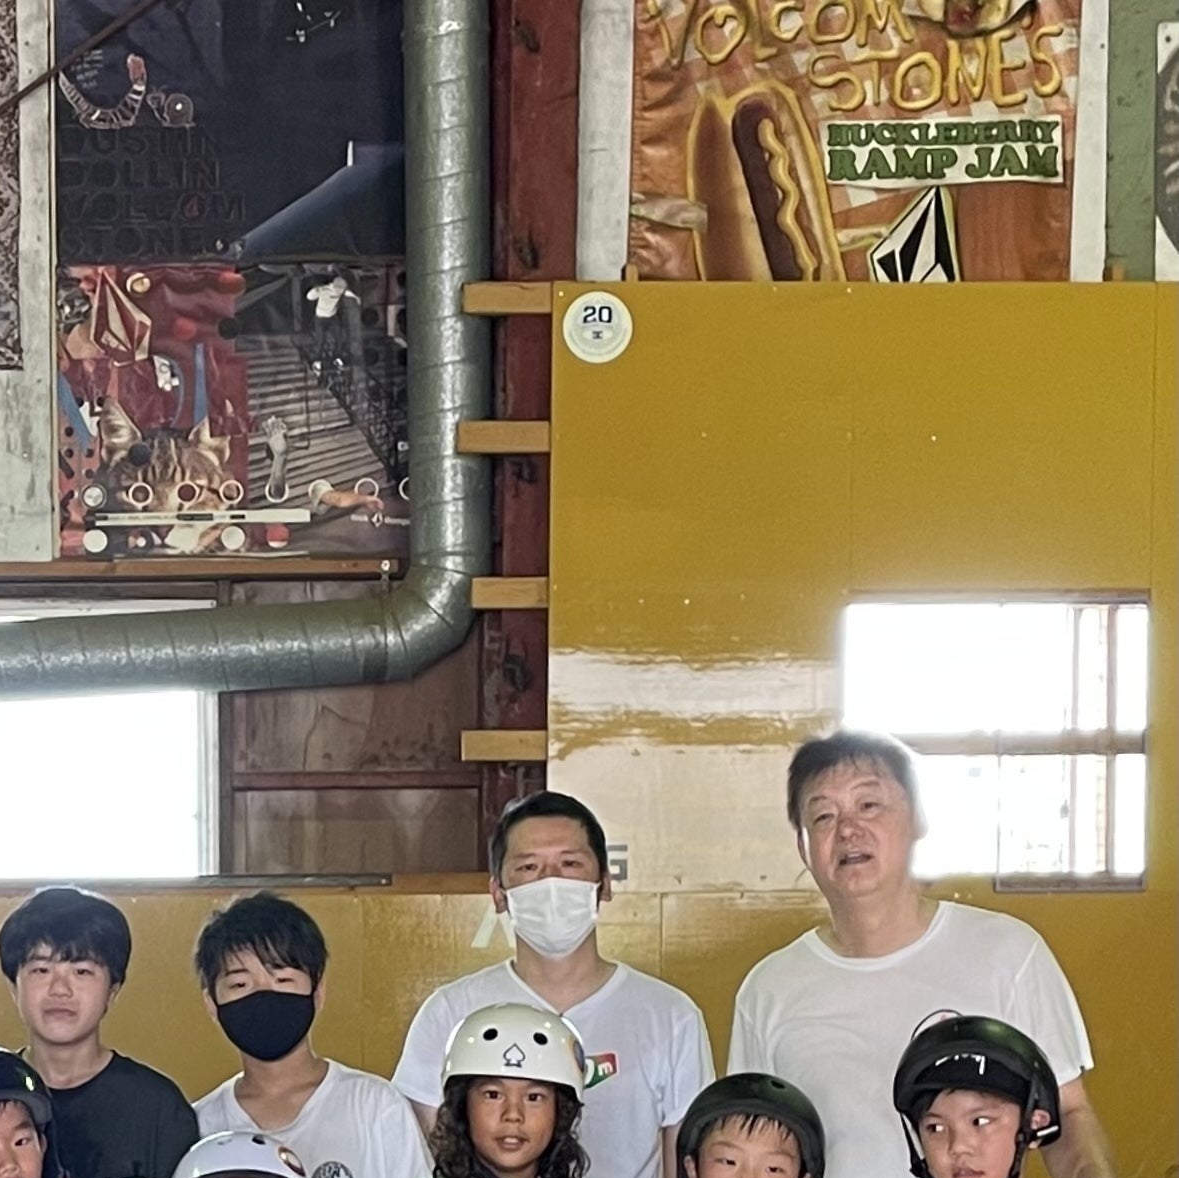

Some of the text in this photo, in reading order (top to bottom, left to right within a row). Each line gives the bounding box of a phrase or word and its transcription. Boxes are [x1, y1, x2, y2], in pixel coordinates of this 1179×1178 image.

[809, 24, 1064, 112] STONES
[828, 119, 1060, 147] HUCKLEBERRY
[828, 146, 1060, 181] RAMP JAM
[582, 305, 613, 324] 20
